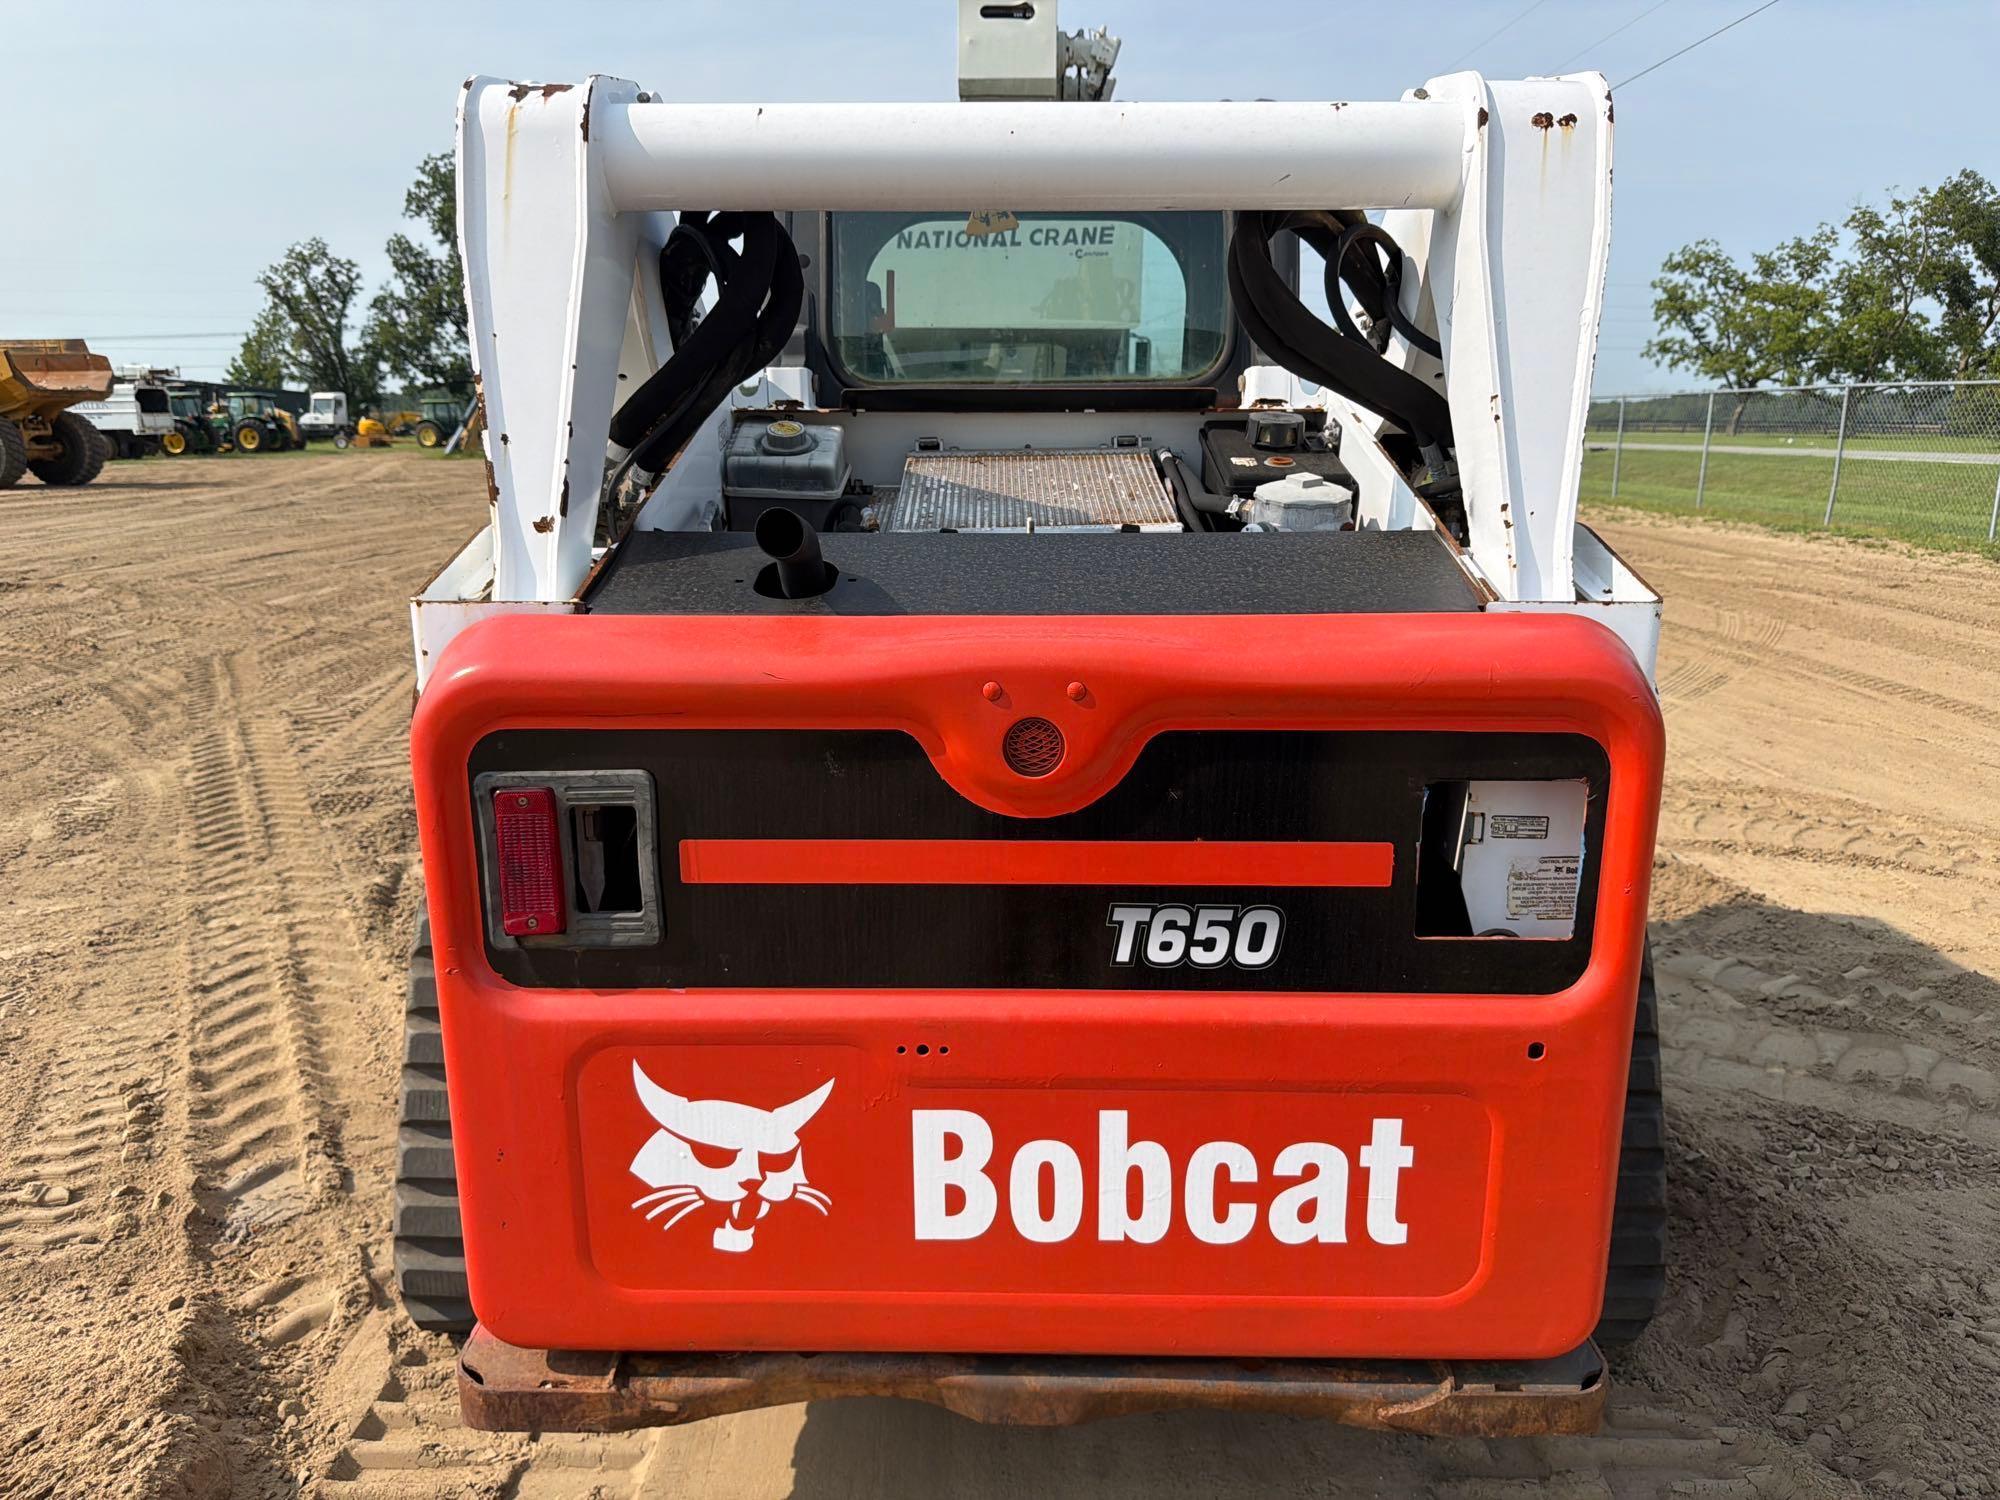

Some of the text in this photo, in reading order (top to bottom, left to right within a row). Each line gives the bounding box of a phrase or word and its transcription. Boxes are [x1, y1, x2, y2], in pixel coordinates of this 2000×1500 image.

[896, 224, 1115, 250] NATIONAL CRANE
[1109, 904, 1284, 968] T650
[911, 1109, 1415, 1245] Bobcat
